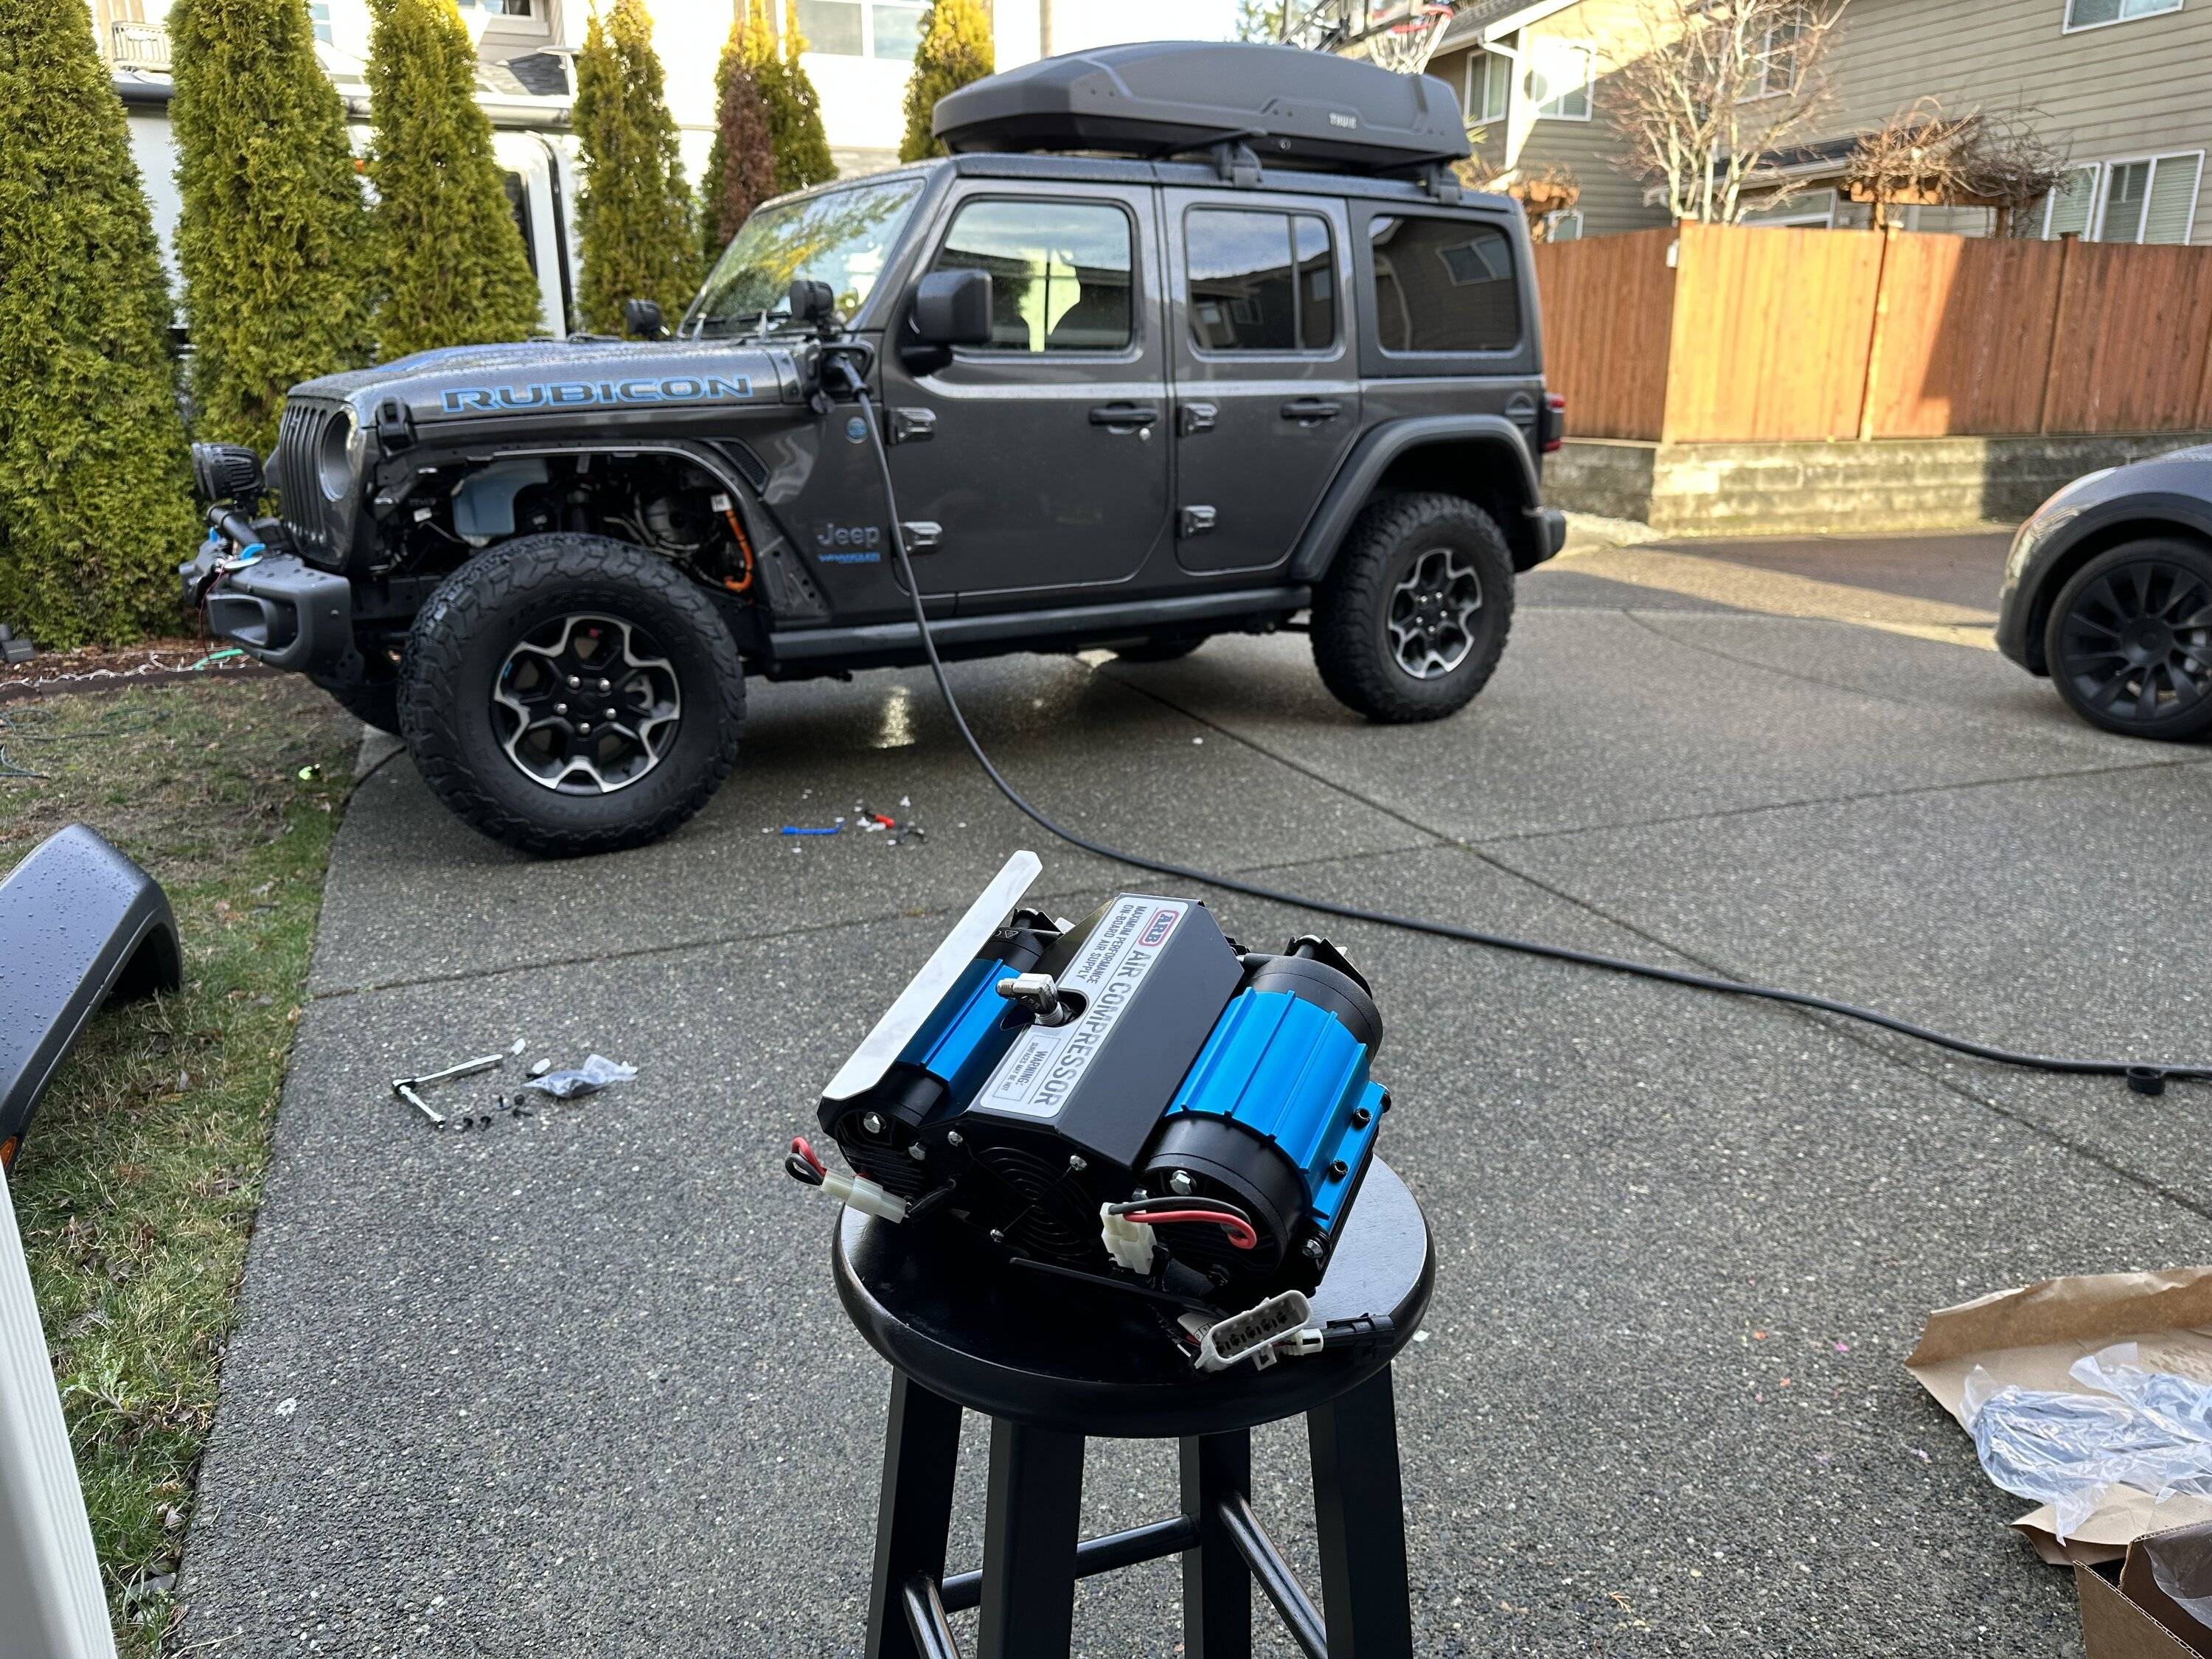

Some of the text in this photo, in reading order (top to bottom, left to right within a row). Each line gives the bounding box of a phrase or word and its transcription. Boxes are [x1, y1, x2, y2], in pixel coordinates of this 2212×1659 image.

[442, 375, 753, 413] RUBICON
[817, 522, 880, 549] Jeep
[1077, 904, 1133, 979] ON-BOARD AIR SUPPLY
[1144, 914, 1173, 942] ARB
[1086, 905, 1147, 984] MAXIMUM PERFORMANCE
[1034, 950, 1151, 1106] AIR COMPRESSOR
[1015, 1051, 1048, 1085] WARNING:
[1019, 1042, 1038, 1064] SURFACES
[1012, 1064, 1023, 1074] MAY
[1001, 1081, 1012, 1091] HOT
